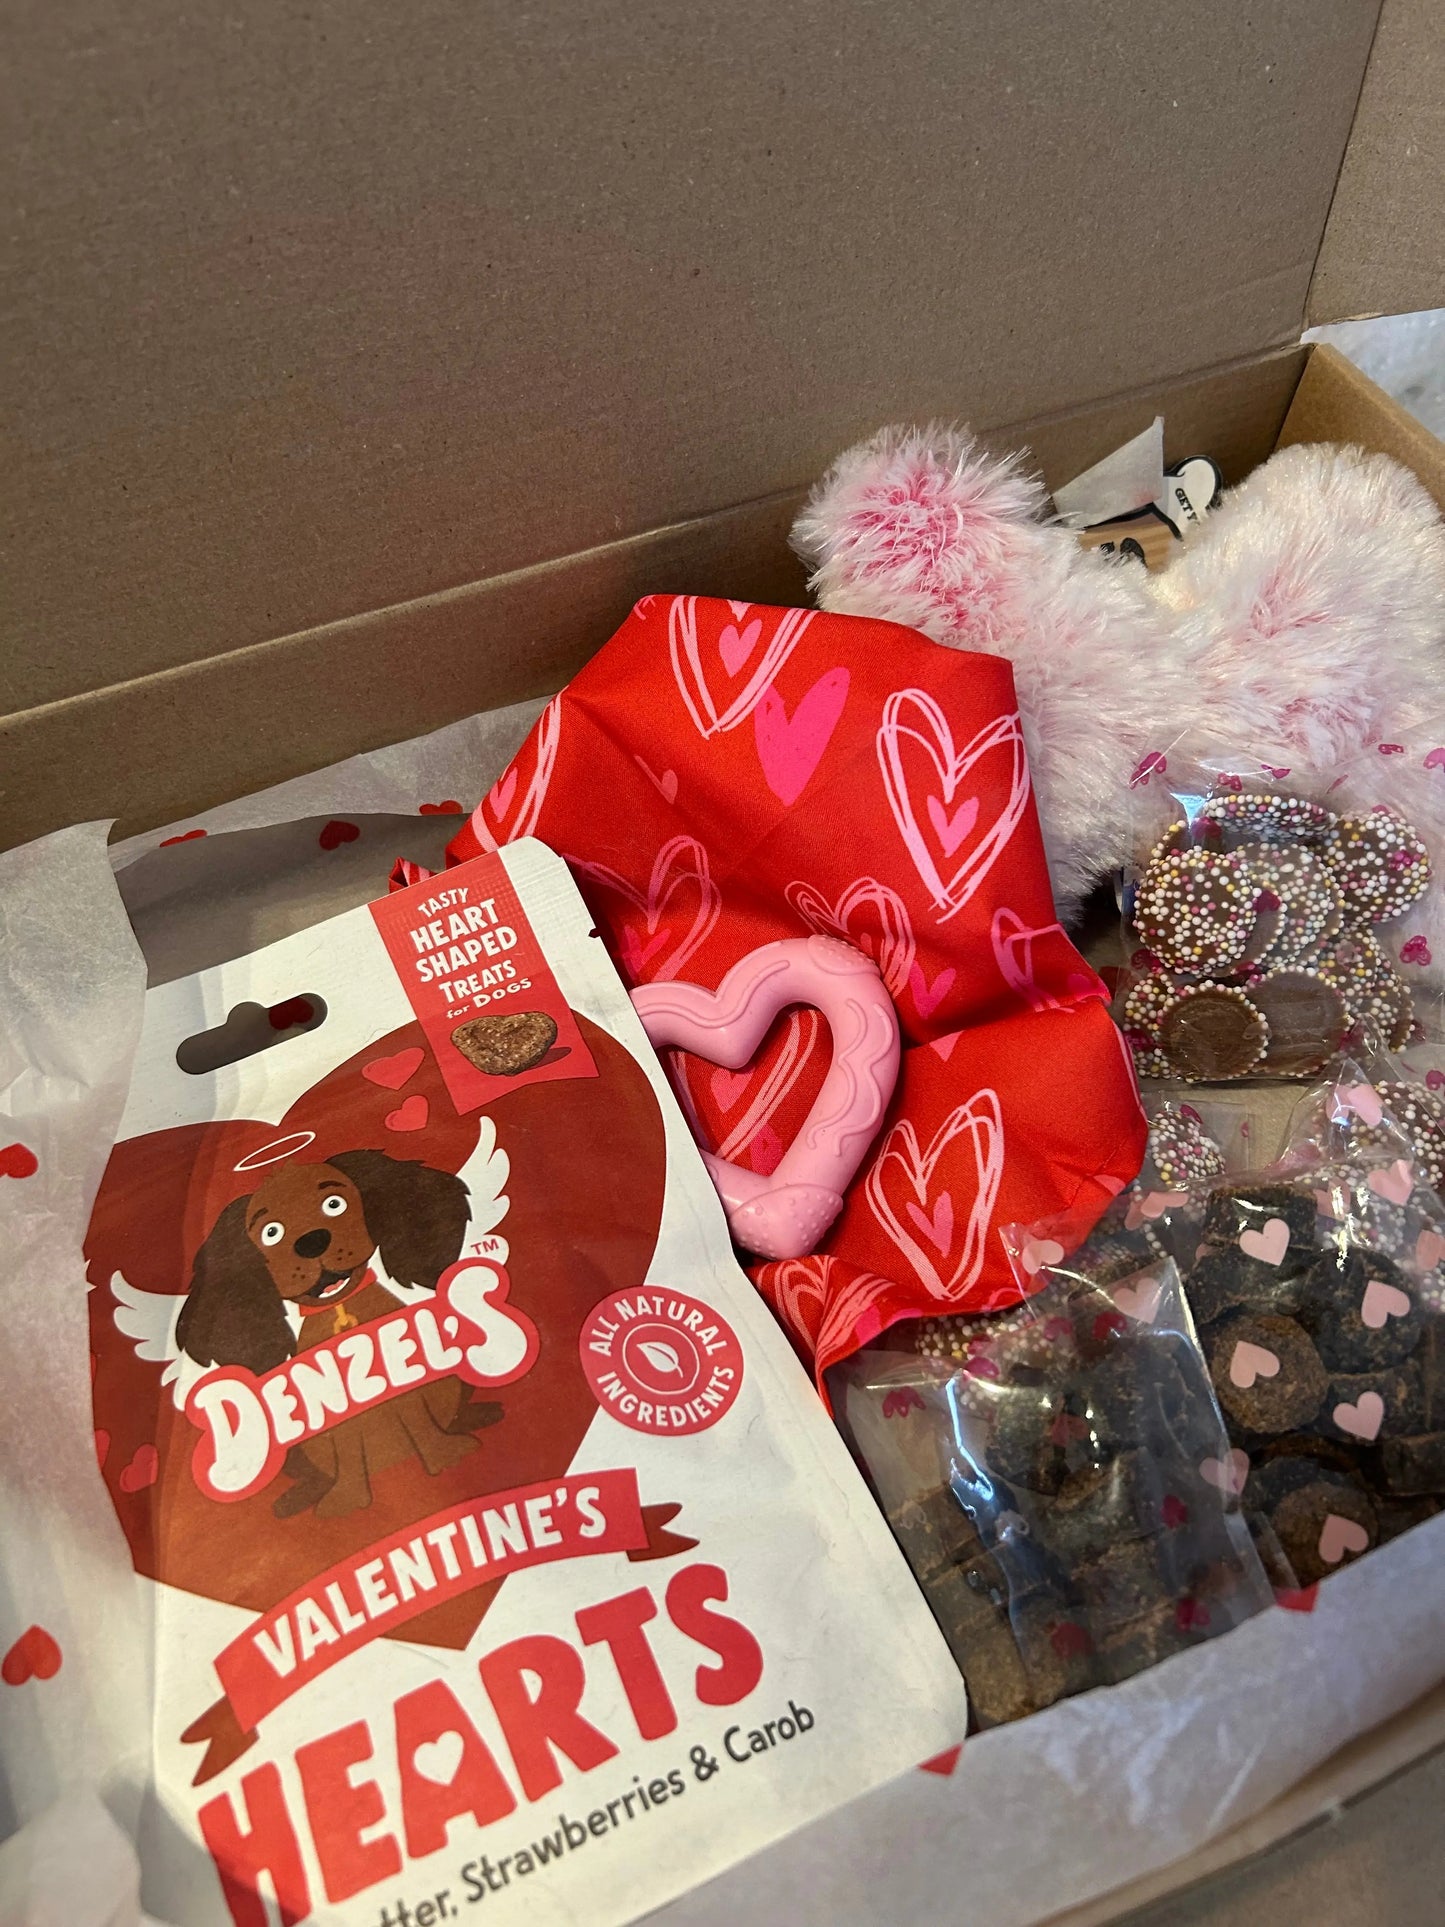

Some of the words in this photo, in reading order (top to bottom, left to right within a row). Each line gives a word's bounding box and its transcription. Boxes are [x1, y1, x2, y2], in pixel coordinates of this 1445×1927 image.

[409, 897, 500, 954] HEART
[417, 887, 469, 918] TASTY
[415, 926, 518, 983] SHAPED
[438, 959, 517, 1004] TREATS
[446, 1004, 471, 1019] for
[472, 978, 532, 1008] DOGS
[589, 1315, 620, 1357] ALL
[614, 1295, 728, 1356] NATURAL
[194, 1265, 528, 1493] DENZEL'S
[596, 1365, 735, 1428] INGREDIENTS
[253, 1486, 607, 1679] VALENTINE'S
[197, 1563, 764, 1927] HEARTS
[460, 1768, 687, 1903] Strawberries
[689, 1744, 720, 1782] &
[723, 1700, 816, 1763] Carob
